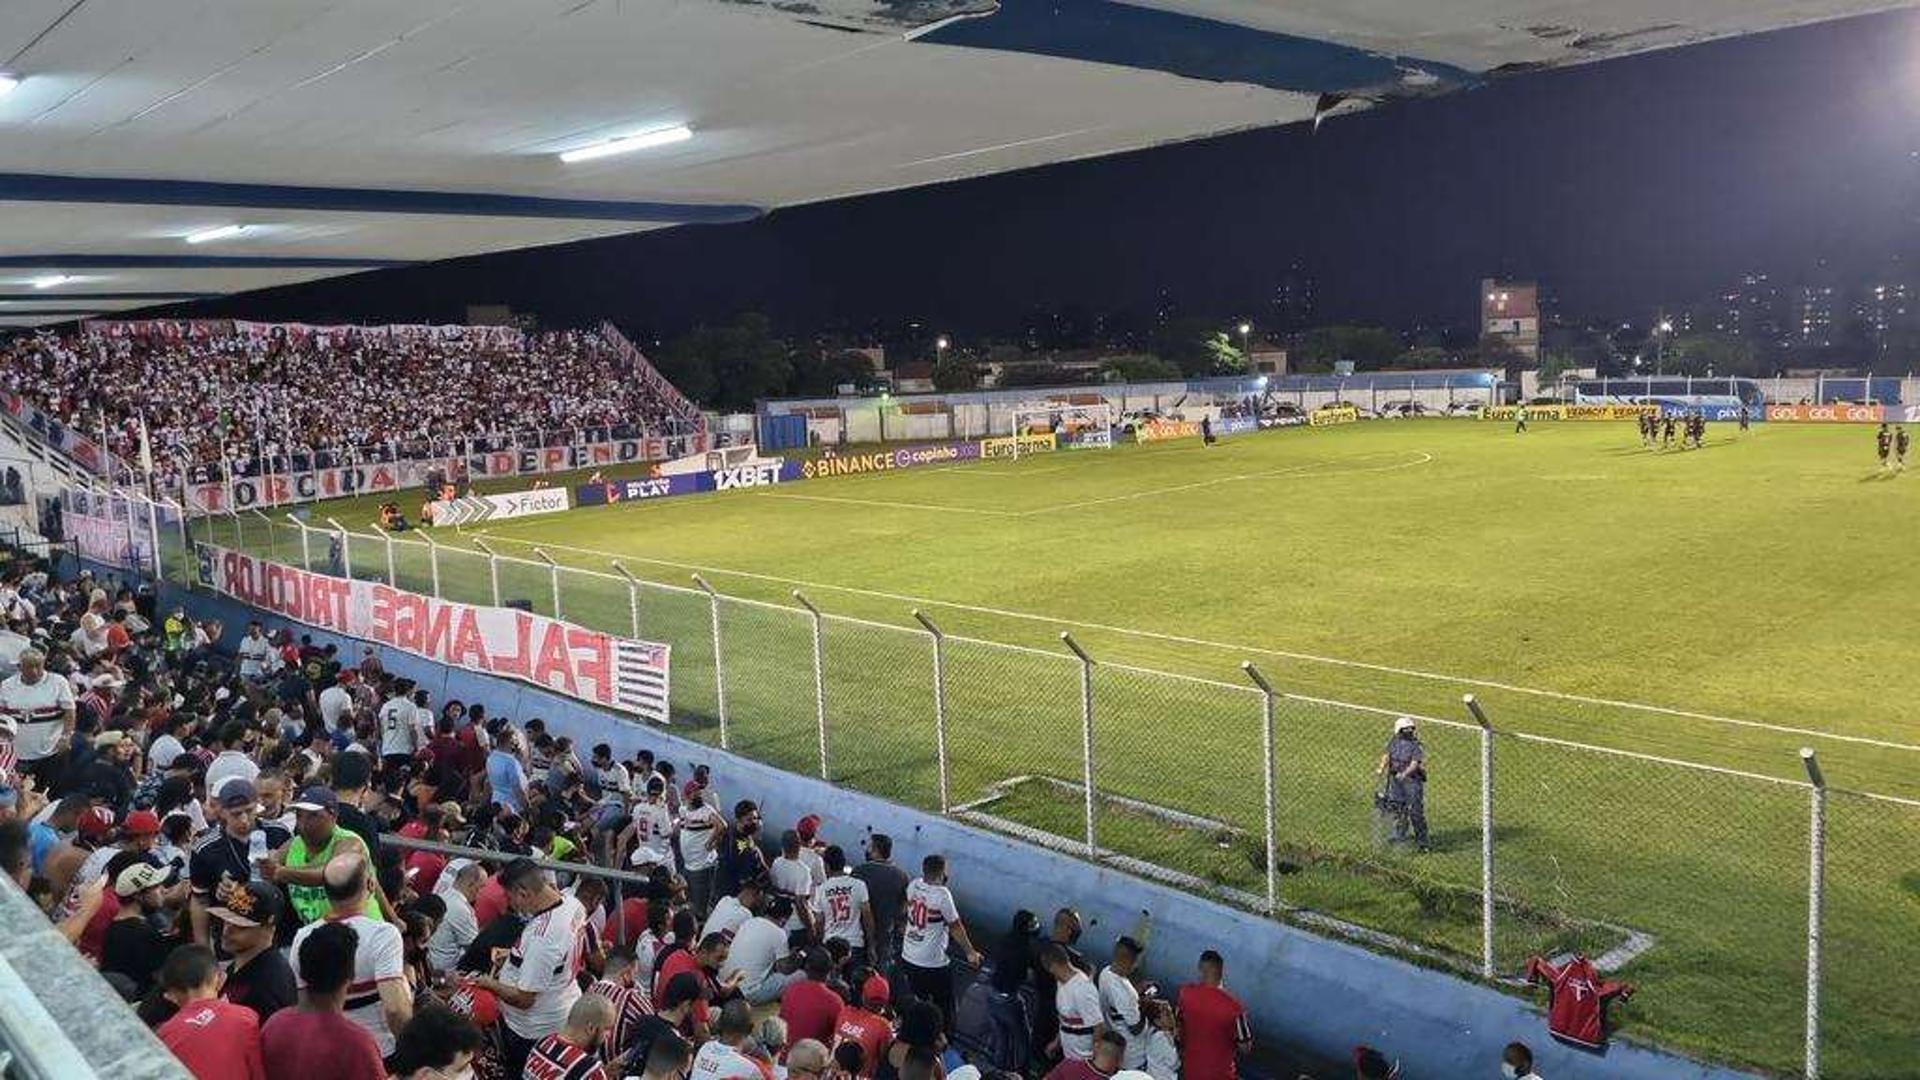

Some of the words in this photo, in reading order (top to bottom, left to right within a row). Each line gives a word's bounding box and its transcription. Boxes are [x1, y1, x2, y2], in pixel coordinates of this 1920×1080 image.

[1484, 406, 1560, 420] Euroarma
[1772, 407, 1801, 420] GOL
[1809, 407, 1838, 420] GOL
[1847, 407, 1877, 420] GOL
[817, 453, 895, 477] BINANCE
[713, 464, 782, 491] 1XBET
[628, 483, 671, 498] PLAY
[520, 494, 562, 513] Fictor
[388, 708, 398, 730] 5
